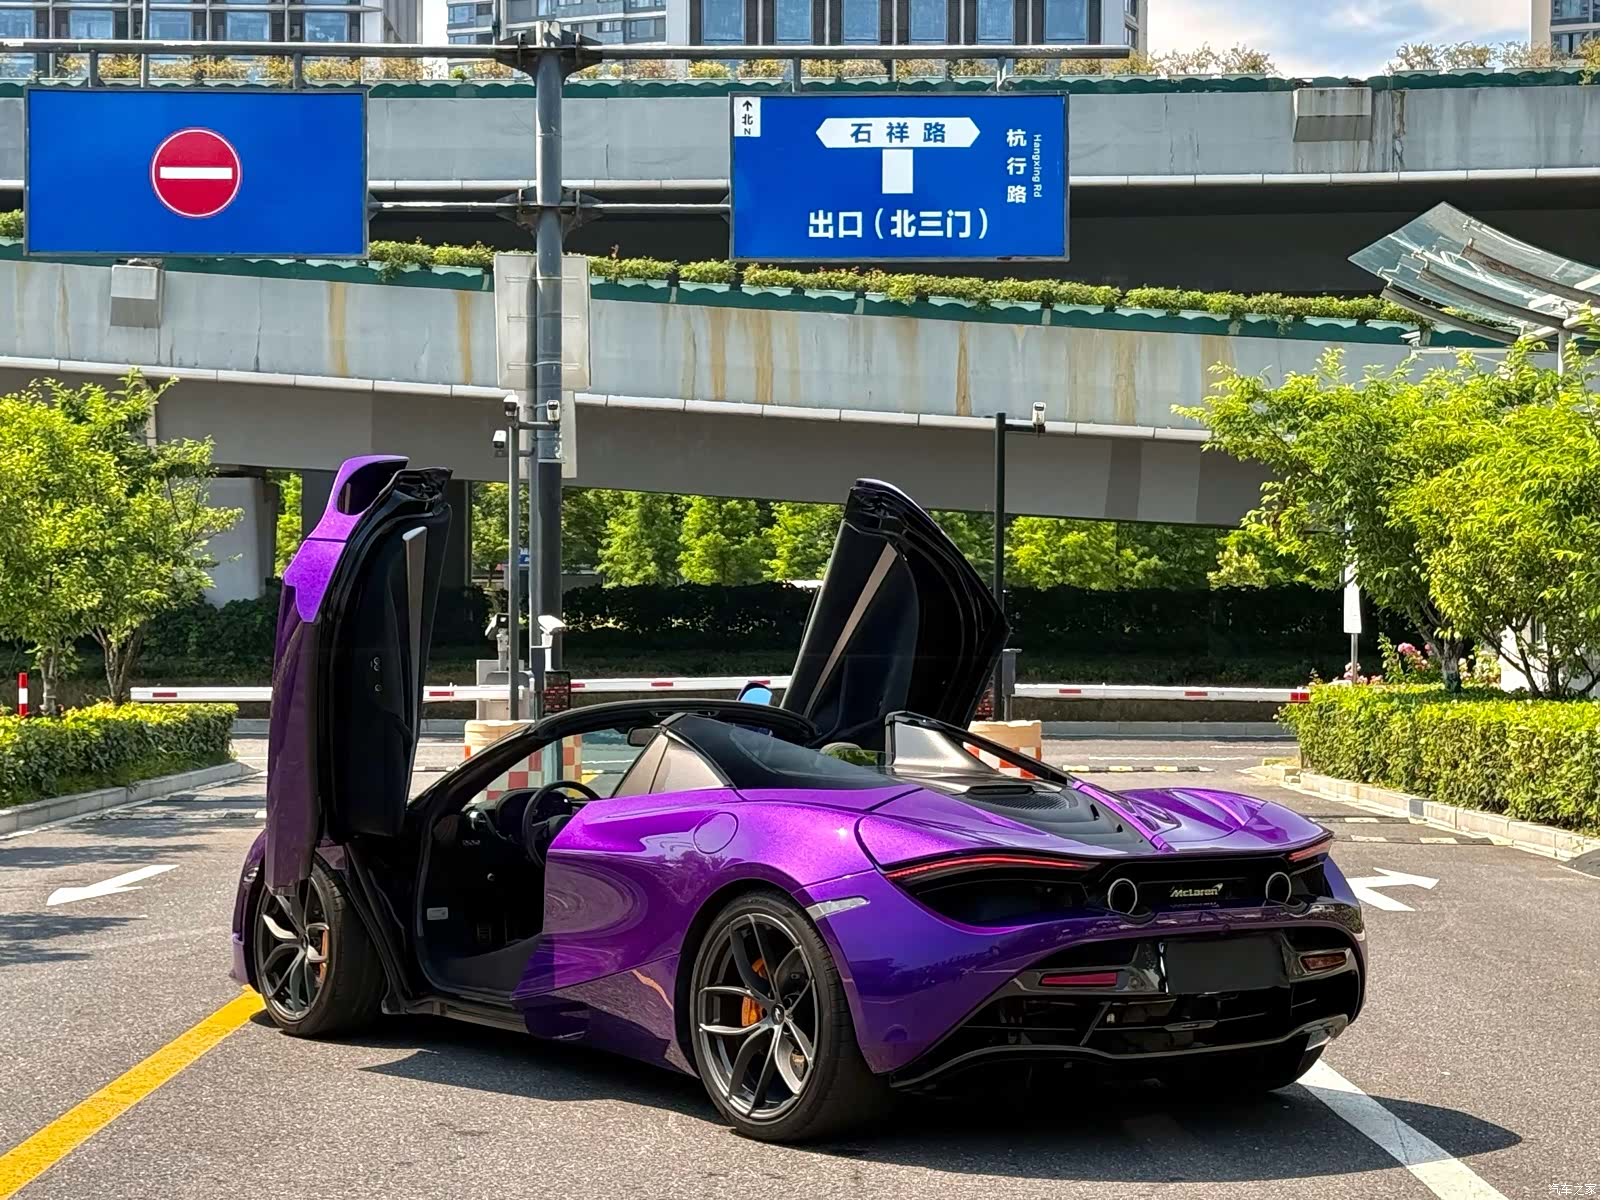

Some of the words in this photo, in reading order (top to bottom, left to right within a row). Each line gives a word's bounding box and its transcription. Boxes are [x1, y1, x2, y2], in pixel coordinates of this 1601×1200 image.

[741, 113, 753, 126] 北
[743, 127, 751, 135] N
[850, 121, 946, 143] 石祥路
[1032, 134, 1042, 183] Hangxing
[1006, 128, 1027, 204] 杭行路
[1033, 184, 1043, 198] Rd
[1169, 886, 1220, 898] McLaren
